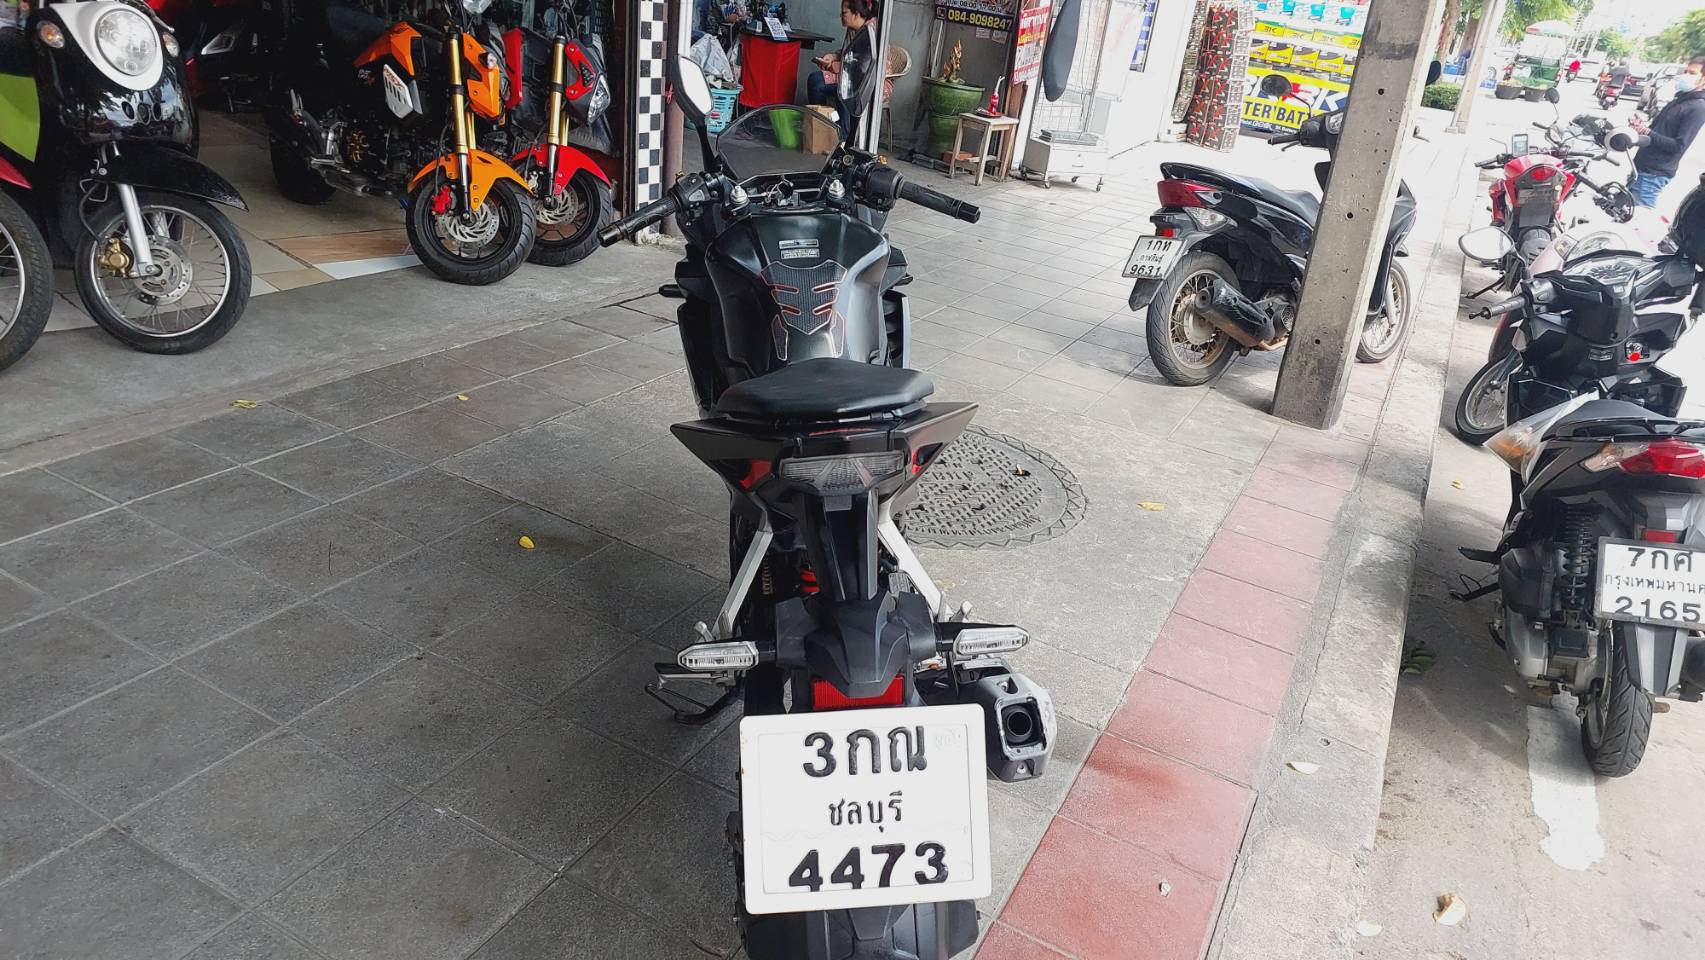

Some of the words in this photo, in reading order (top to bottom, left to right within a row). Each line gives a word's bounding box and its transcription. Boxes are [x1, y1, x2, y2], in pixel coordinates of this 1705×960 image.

[947, 9, 1012, 30] 084-9098247
[1146, 239, 1172, 252] 1กท
[1129, 264, 1162, 277] 9631
[1628, 547, 1693, 572] 7กศ
[1615, 596, 1702, 623] 2165
[803, 725, 927, 777] 3กณ
[828, 790, 903, 832] ชลบุรี
[788, 840, 949, 892] 4473
